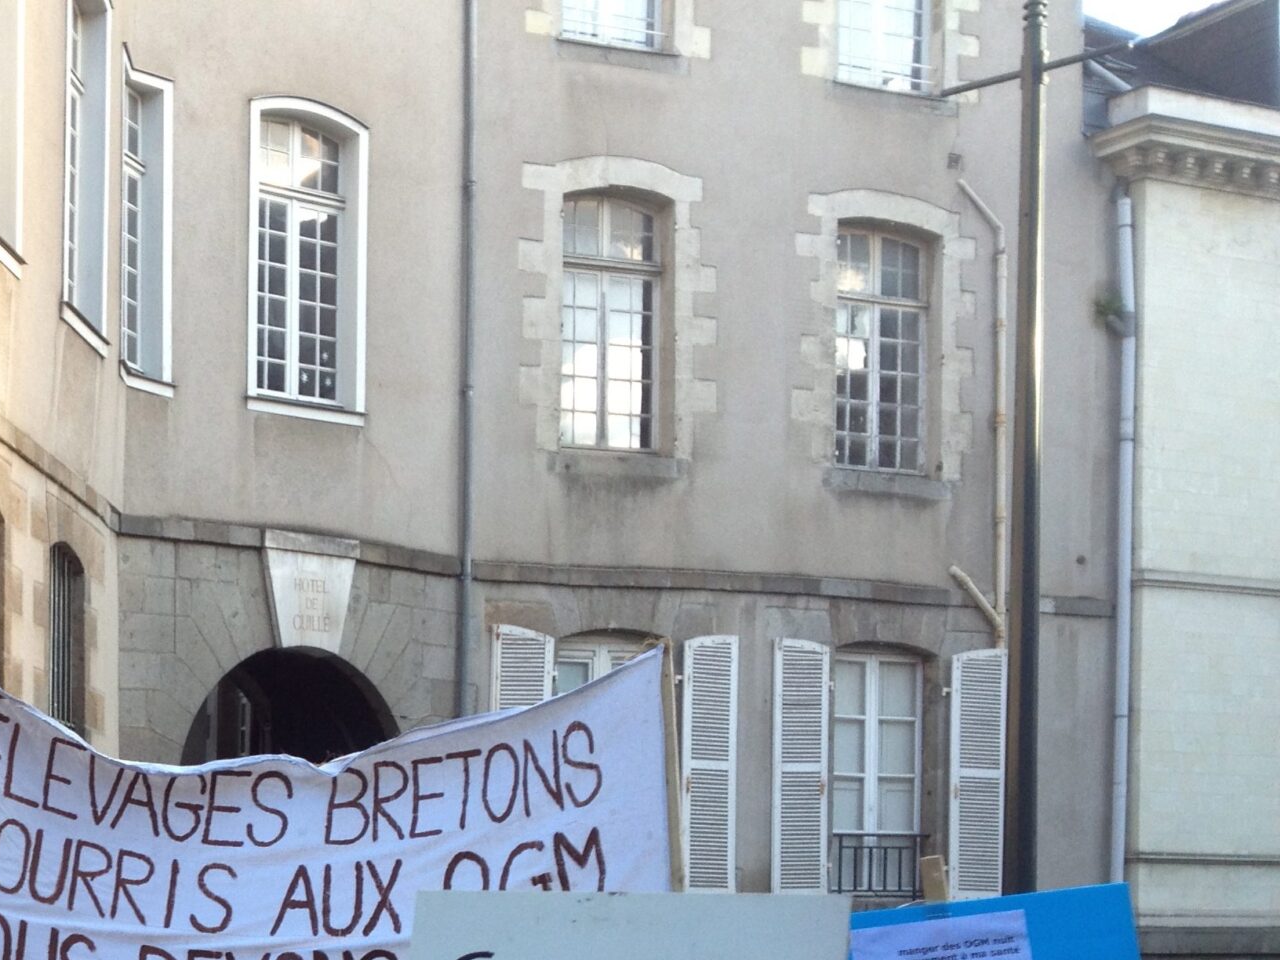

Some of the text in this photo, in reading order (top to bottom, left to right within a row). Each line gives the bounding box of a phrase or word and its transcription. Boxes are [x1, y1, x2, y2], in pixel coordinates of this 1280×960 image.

[304, 597, 318, 610] DE
[324, 721, 602, 845] BRETONS
[270, 859, 402, 936] AUX
[941, 941, 961, 951] des
[964, 938, 990, 948] OGM
[993, 935, 1015, 945] nuit
[971, 951, 987, 959] ma
